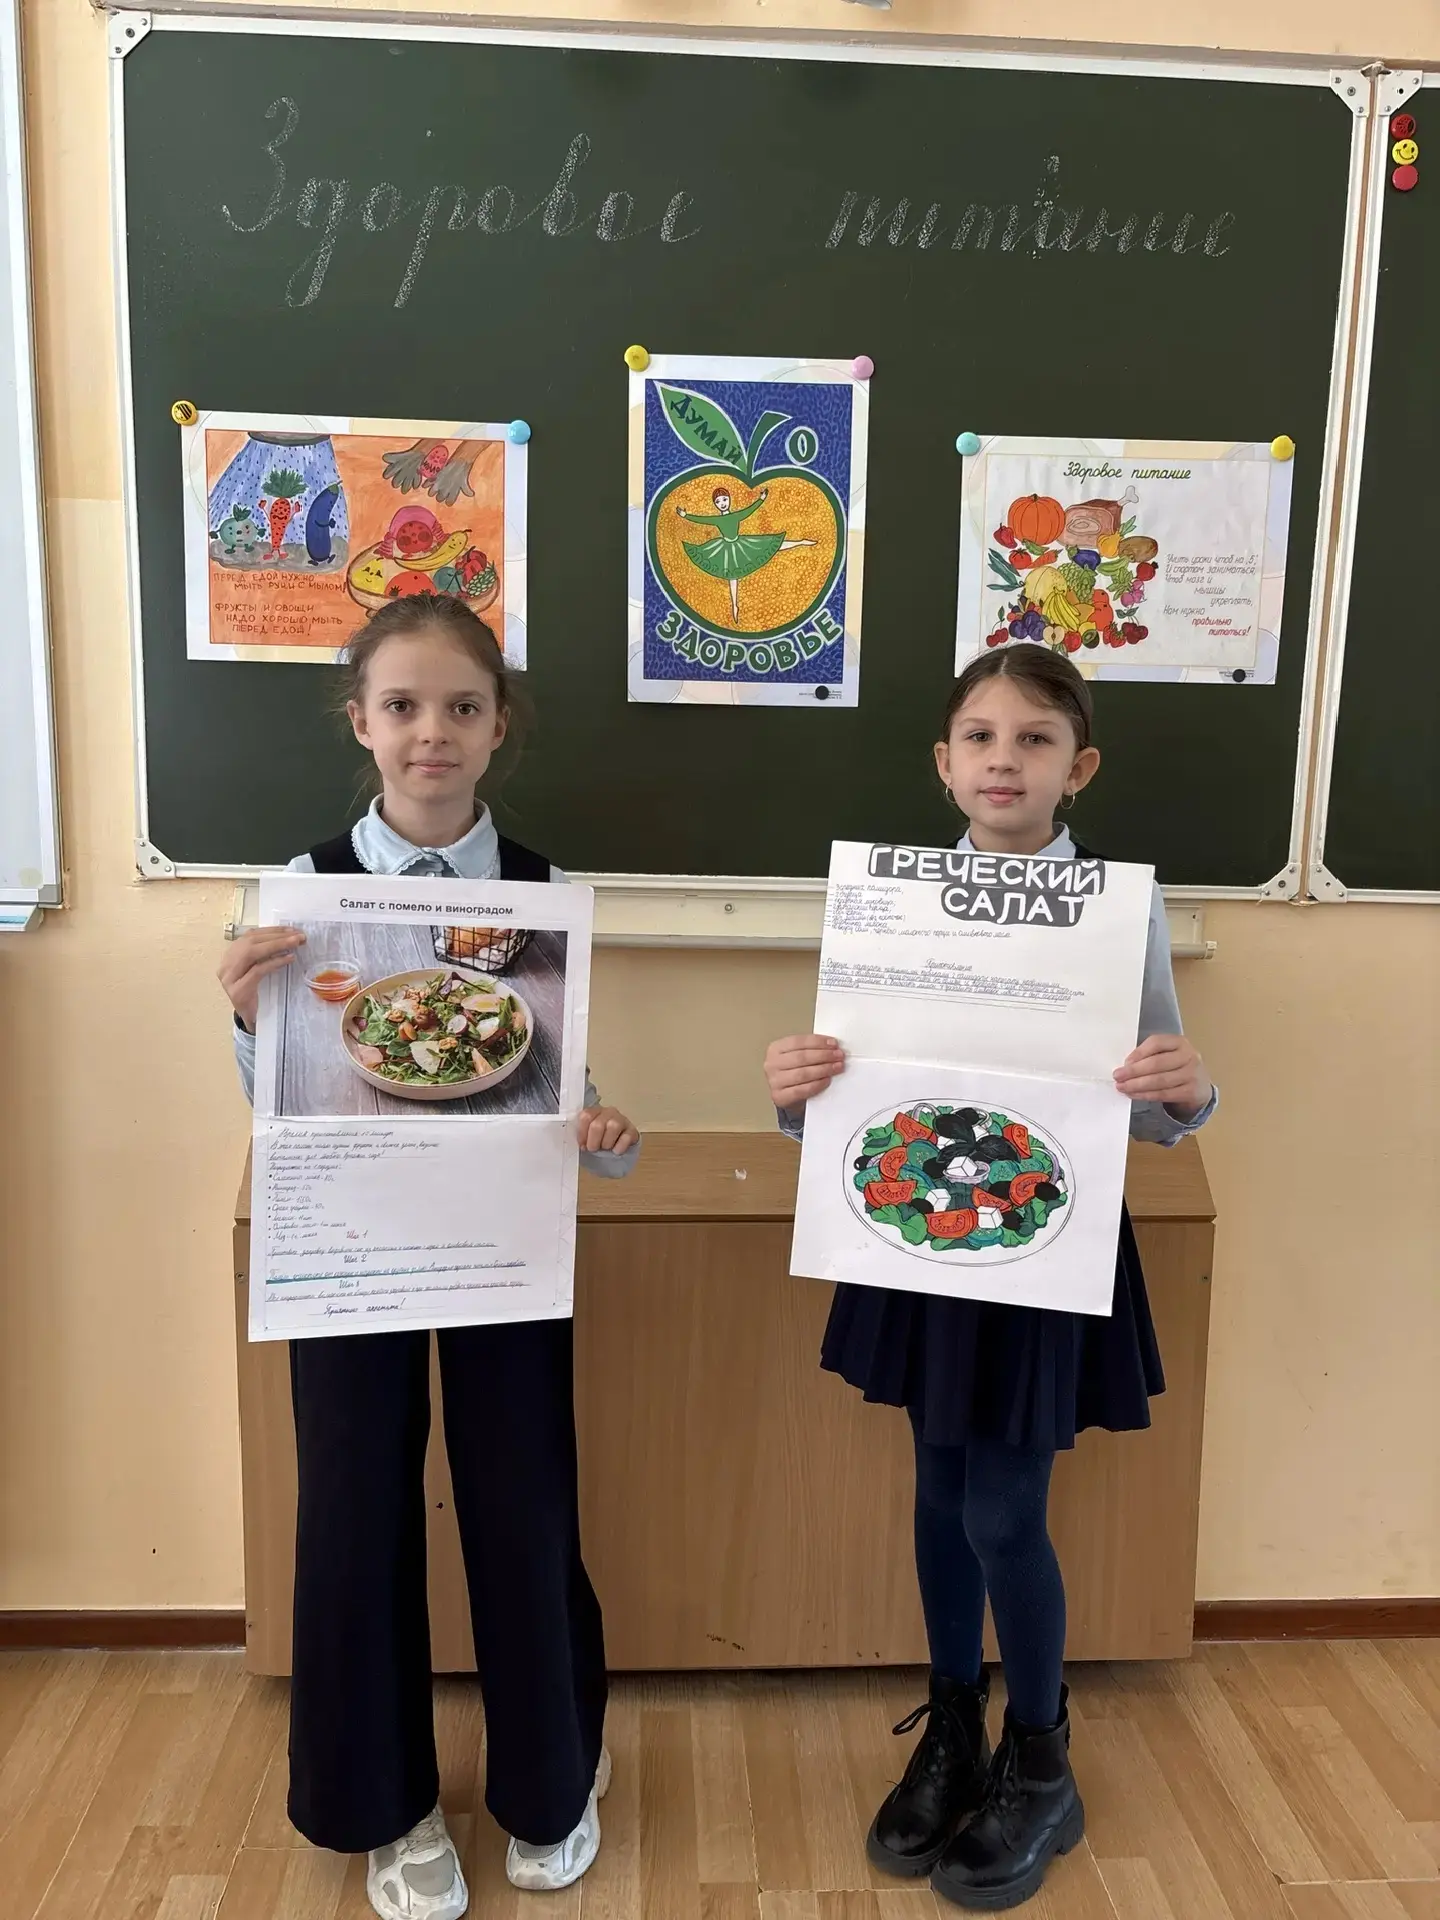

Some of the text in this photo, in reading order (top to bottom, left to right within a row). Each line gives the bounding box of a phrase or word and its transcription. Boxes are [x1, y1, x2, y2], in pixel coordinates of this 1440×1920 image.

[221, 97, 1236, 308] Здоровое питание
[669, 393, 744, 466] ДУМАЙ
[1063, 461, 1192, 485] Здоровое питание
[213, 571, 315, 584] ПЕРЕД ЕДОЙ НУЖНО
[234, 582, 263, 591] МЫТЬ
[214, 602, 315, 613] ФРУКТЫ И ОВОЩИ
[226, 613, 343, 625] НАДО ХОРОШО МЫТЬ
[232, 624, 268, 635] ПЕРЕД
[655, 609, 844, 674] ЗДОРОВЬЕ
[870, 846, 1103, 896] ГРЕЧЕСКИЙ
[340, 898, 513, 917] Салат с помело и виноградом
[943, 886, 1085, 925] САЛАТ
